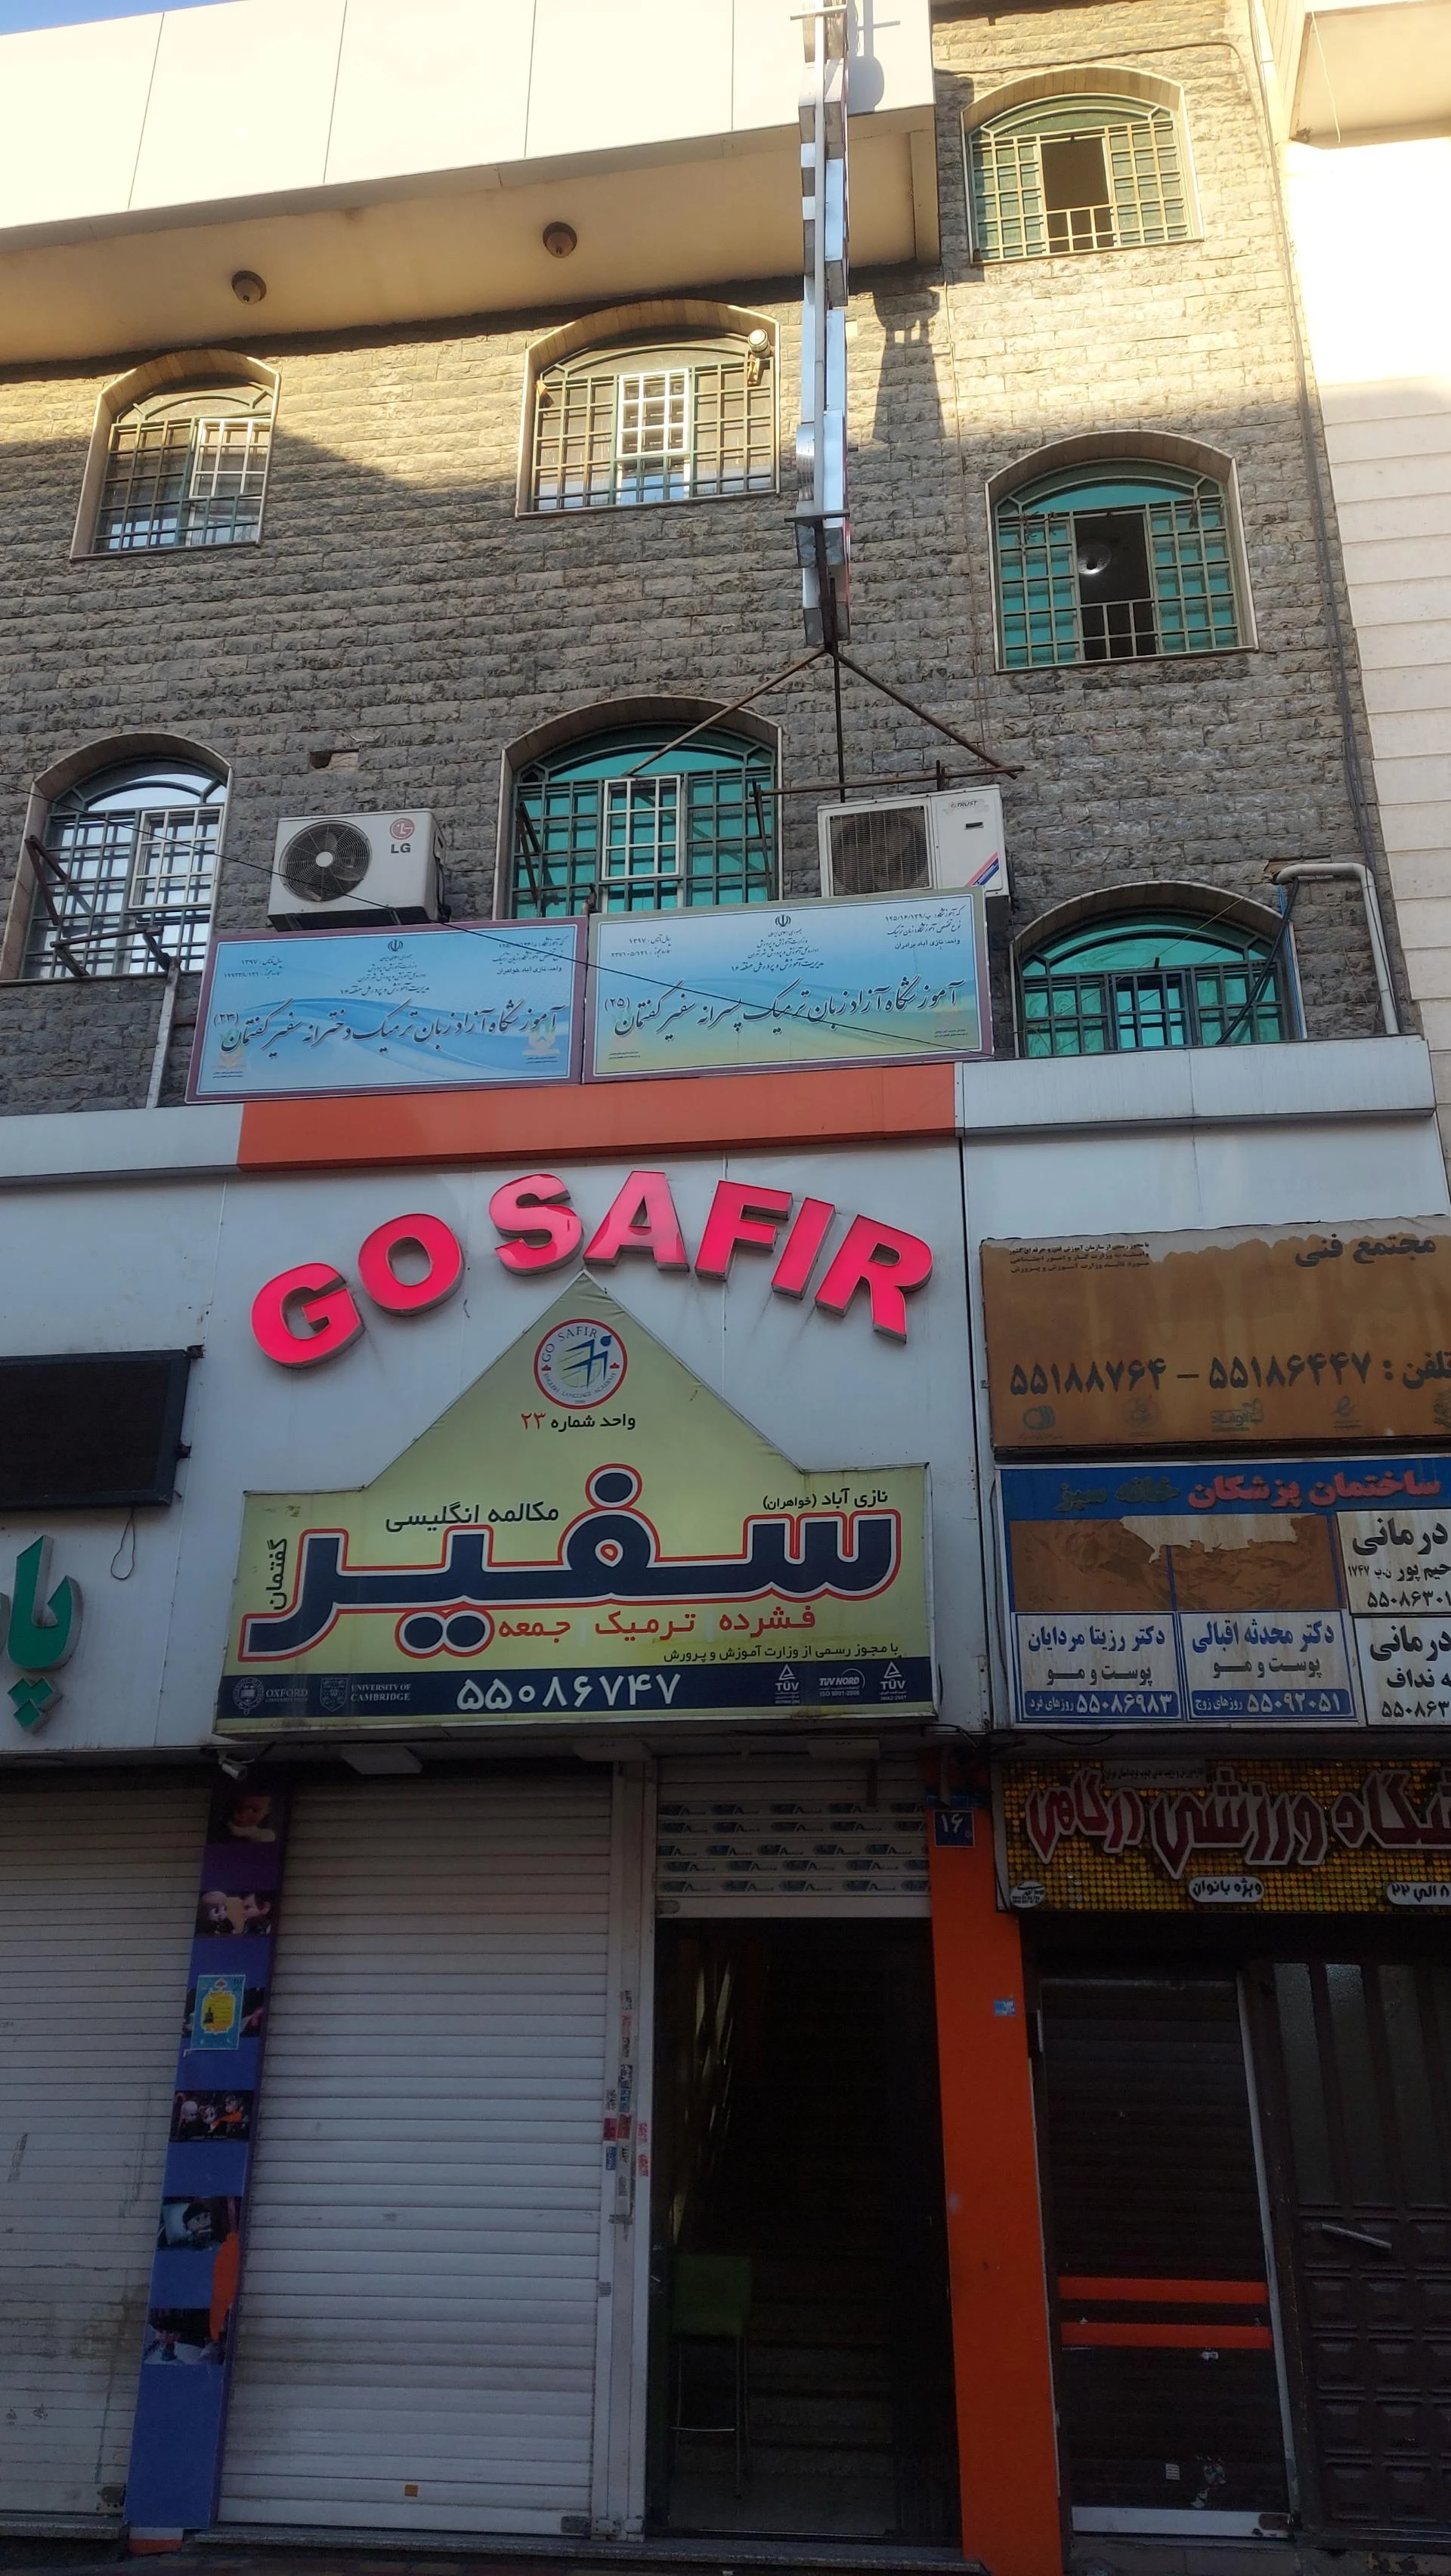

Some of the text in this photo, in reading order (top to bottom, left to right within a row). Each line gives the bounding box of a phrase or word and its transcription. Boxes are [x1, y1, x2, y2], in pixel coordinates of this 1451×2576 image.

[390, 843, 411, 854] LG
[614, 979, 685, 1036] گفتمان
[743, 978, 810, 1033] ترمیک
[806, 990, 847, 1030] زبان
[849, 986, 890, 1013] آزاد
[885, 975, 966, 1012] آموزشگاه
[219, 997, 294, 1053] گفتمان
[302, 1009, 351, 1049] دخترانه
[351, 997, 419, 1055] ترمیک
[414, 1011, 456, 1051] زبان
[454, 1007, 497, 1035] آزاد
[489, 997, 567, 1034] آموزشگاه
[655, 994, 696, 1041] سفیر
[697, 997, 742, 1031] پسرانه
[259, 1011, 302, 1059] سفیر
[1295, 1232, 1437, 1267] مجتمع فنی
[250, 1169, 934, 1370] GO SAFIR
[541, 1325, 598, 1362] GO SAFIR
[1009, 1357, 1167, 1396] ۵۵۱۸۸۷۶۴
[1208, 1350, 1372, 1390] ۵۵۱۸۶۴۴۷
[520, 1412, 636, 1433] واحد شماره ۲۳
[763, 1487, 888, 1511] نازی آباد (خواهران)
[1187, 1474, 1301, 1511] پزشکان
[1307, 1469, 1442, 1507] ساختمان
[385, 1501, 559, 1532] مکالمه انگلیسی
[1352, 1516, 1449, 1557] درمانی
[237, 1463, 902, 1662] سفیر
[265, 1537, 288, 1610] گفتمان
[1347, 1564, 1370, 1578] ۱۷۴۷
[1397, 1564, 1422, 1582] پور
[1366, 1589, 1451, 1609] ۵۵۰۸۶۳۰۱
[498, 1604, 816, 1644] فشرده ترمیک جمعه
[1088, 1625, 1126, 1652] رزیتا
[1131, 1625, 1166, 1652] دکتر
[1192, 1618, 1335, 1654] دکتر محدثه اقبالی
[663, 1642, 899, 1663] با مجوز رسمی از وزارت آموزش و پرورش
[1212, 1657, 1323, 1679] پوست و مو
[265, 1687, 309, 1698] OXFORD
[350, 1682, 412, 1693] UNIVERSITY OF
[456, 1672, 681, 1712] ۵۵۰۸۶۷۴۷
[835, 1677, 860, 1686] NORD
[1045, 1665, 1153, 1687] پوست و مو
[1387, 1668, 1436, 1689] نداف
[350, 1692, 411, 1702] CAMBRIDGE
[1029, 1693, 1173, 1715] ۵۵۰۸۶۹۸۳ روزهای فرد
[1194, 1692, 1341, 1713] ۵۵۰۹۲۰۵۱ روزهای زوج
[941, 1813, 964, 1834] ۱۶
[1149, 1766, 1328, 1880] ورزشی
[1192, 1877, 1263, 1899] ویژه بانوان
[1413, 1884, 1437, 1903] الی
